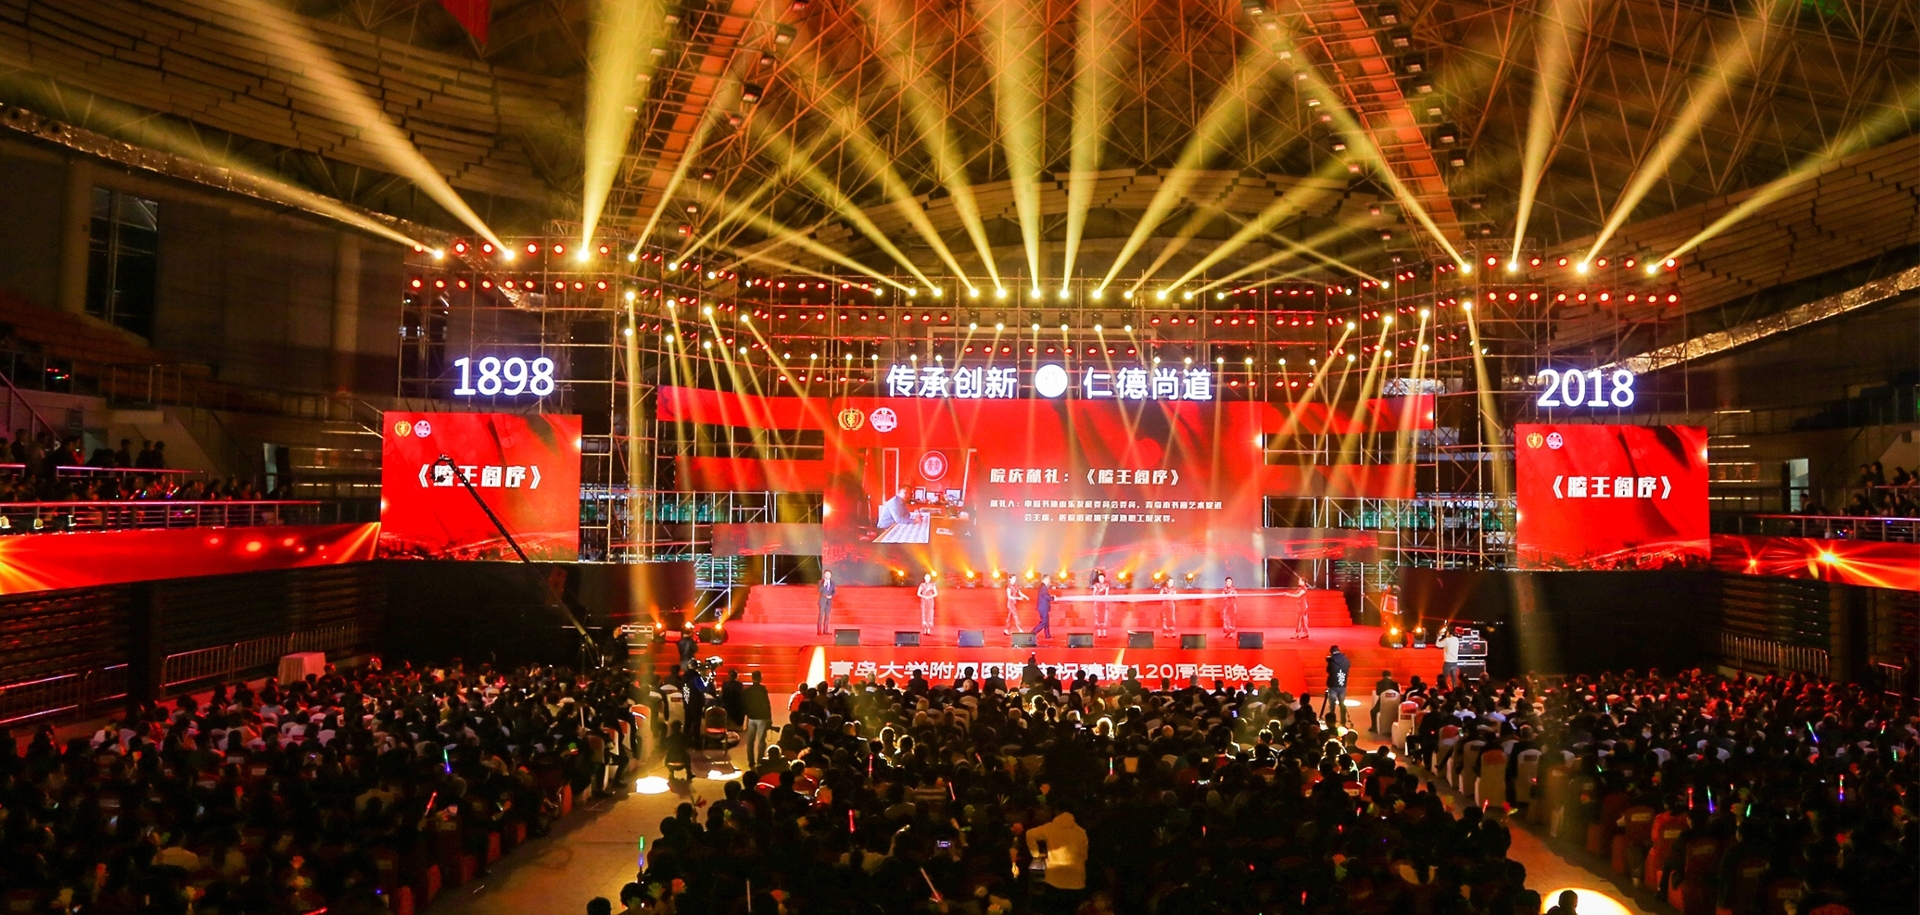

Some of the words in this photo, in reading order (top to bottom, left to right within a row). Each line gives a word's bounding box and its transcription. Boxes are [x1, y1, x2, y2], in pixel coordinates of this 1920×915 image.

[454, 356, 555, 396] 1898
[886, 365, 1018, 399] 传承创新
[1082, 367, 1213, 401] 仁德尚道
[1536, 368, 1635, 408] 2018
